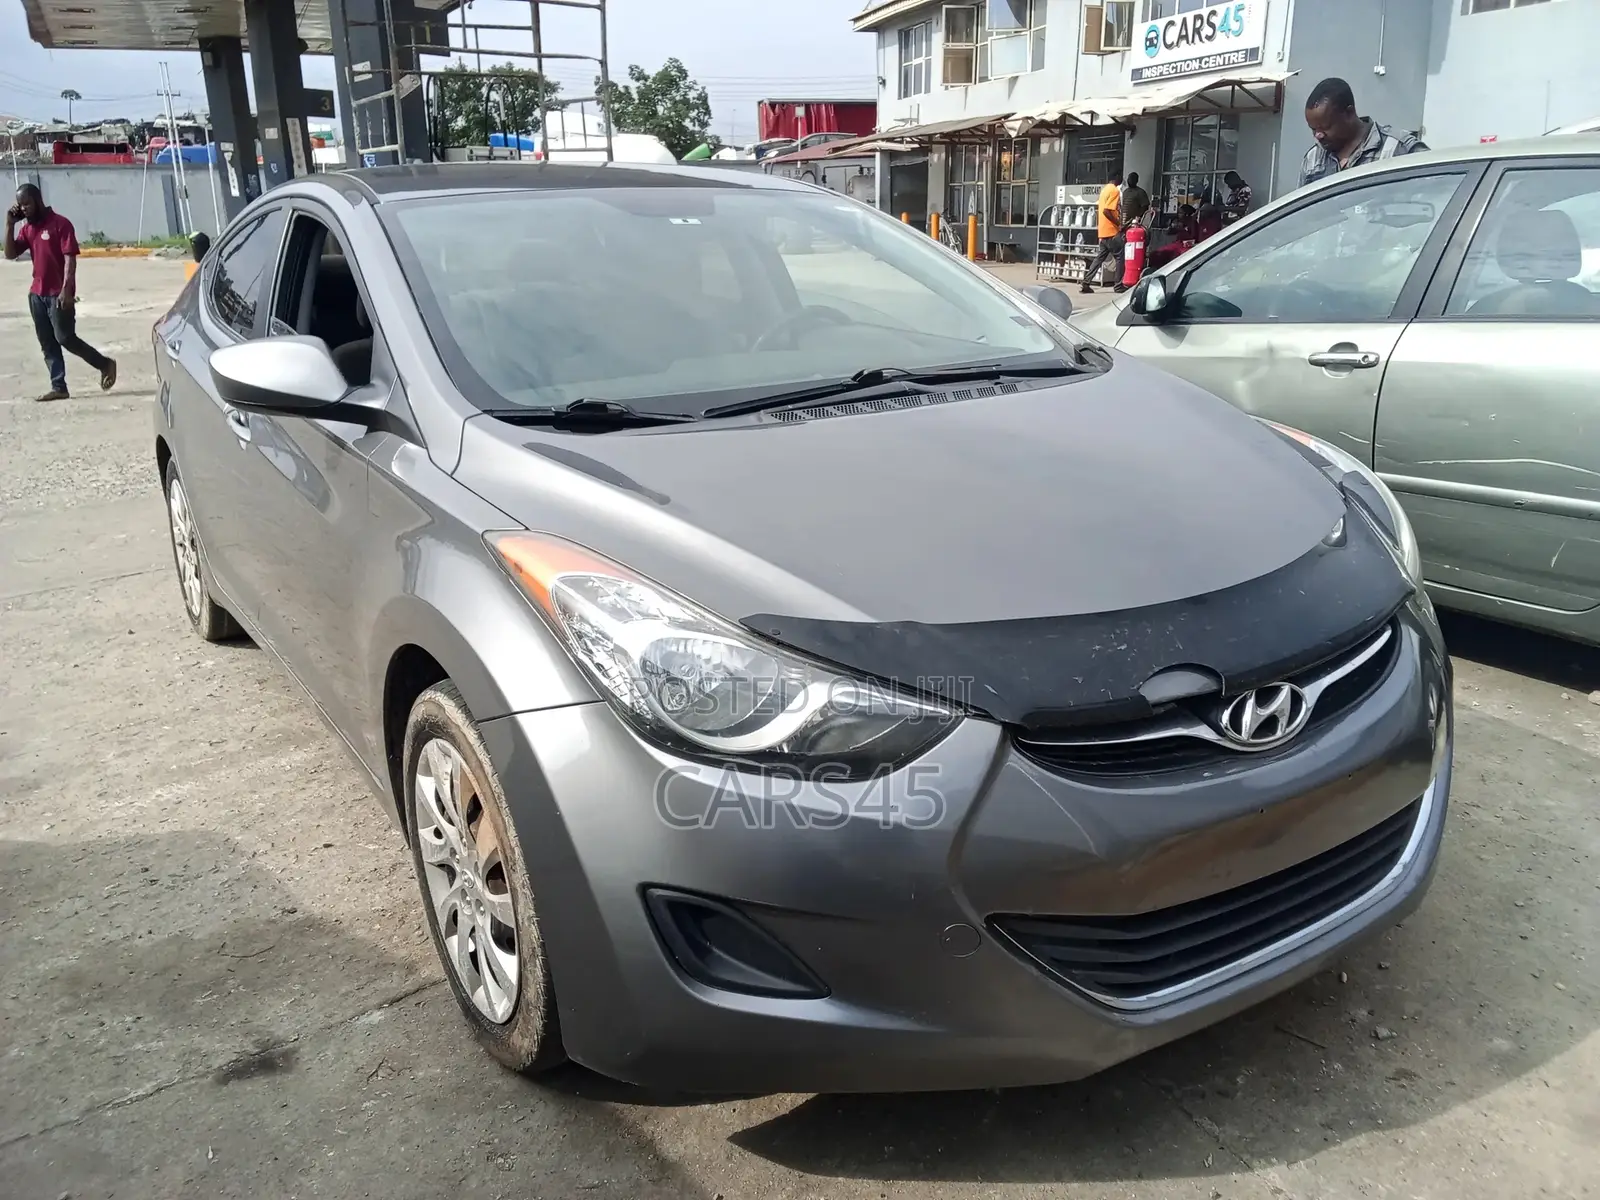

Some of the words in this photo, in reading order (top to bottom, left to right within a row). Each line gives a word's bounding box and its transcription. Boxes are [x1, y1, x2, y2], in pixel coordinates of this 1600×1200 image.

[1162, 4, 1246, 50] CARS45
[1142, 60, 1201, 79] INSPECTION
[1201, 50, 1247, 69] CENTRE
